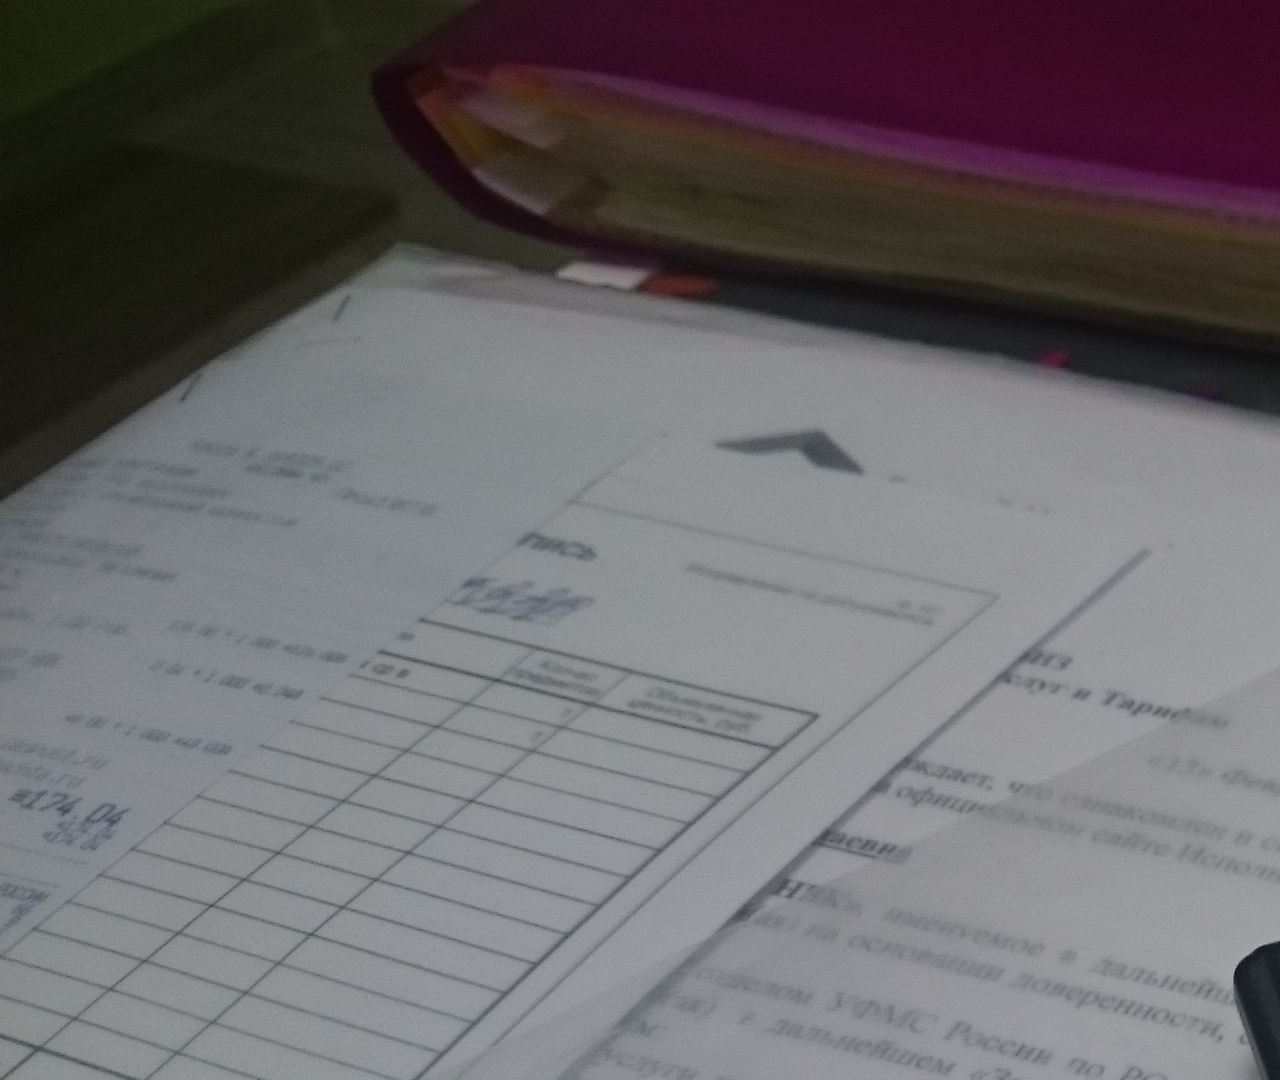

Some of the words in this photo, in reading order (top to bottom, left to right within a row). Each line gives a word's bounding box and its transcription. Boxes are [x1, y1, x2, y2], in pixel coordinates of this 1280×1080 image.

[1089, 828, 1172, 858] сайте
[1008, 970, 1225, 1043] доверенности,
[943, 1018, 1054, 1067] России
[1065, 1056, 1106, 1080] по
